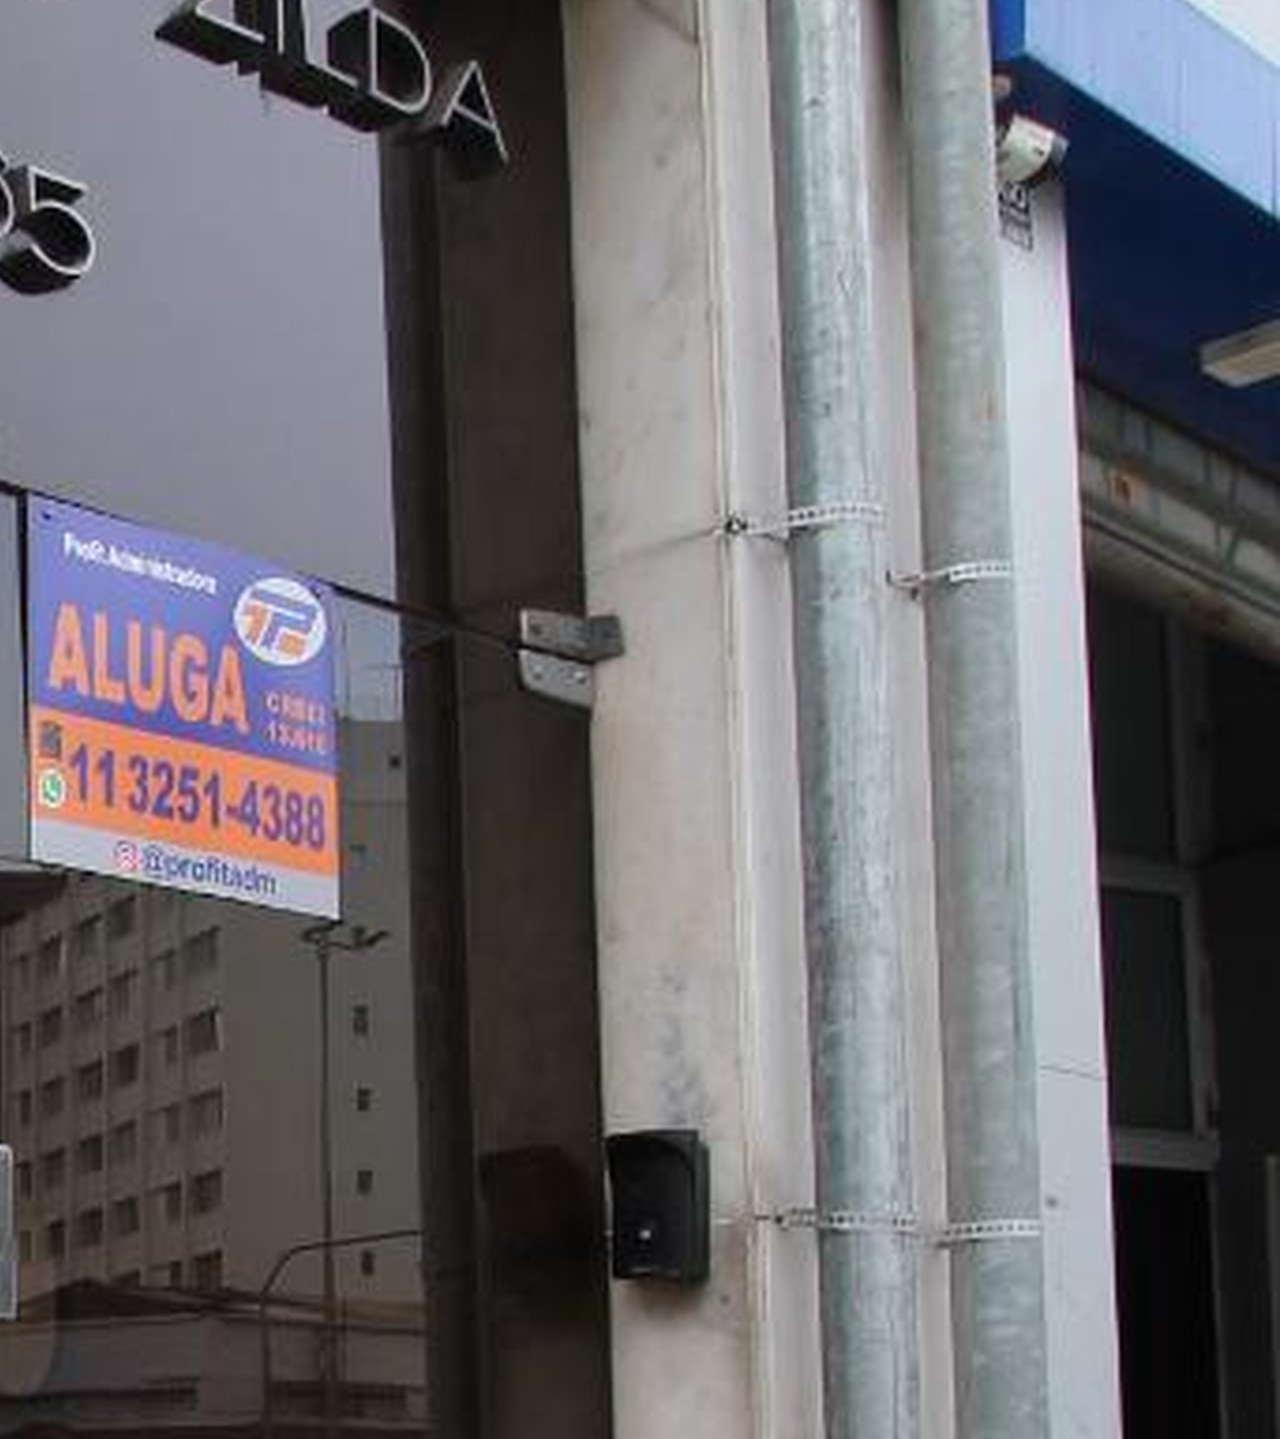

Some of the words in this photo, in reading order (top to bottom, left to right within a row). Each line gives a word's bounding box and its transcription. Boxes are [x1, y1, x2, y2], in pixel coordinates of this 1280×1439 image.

[47, 600, 251, 736] ALUGA
[70, 743, 115, 808] 11
[128, 754, 326, 852] 3251-4388
